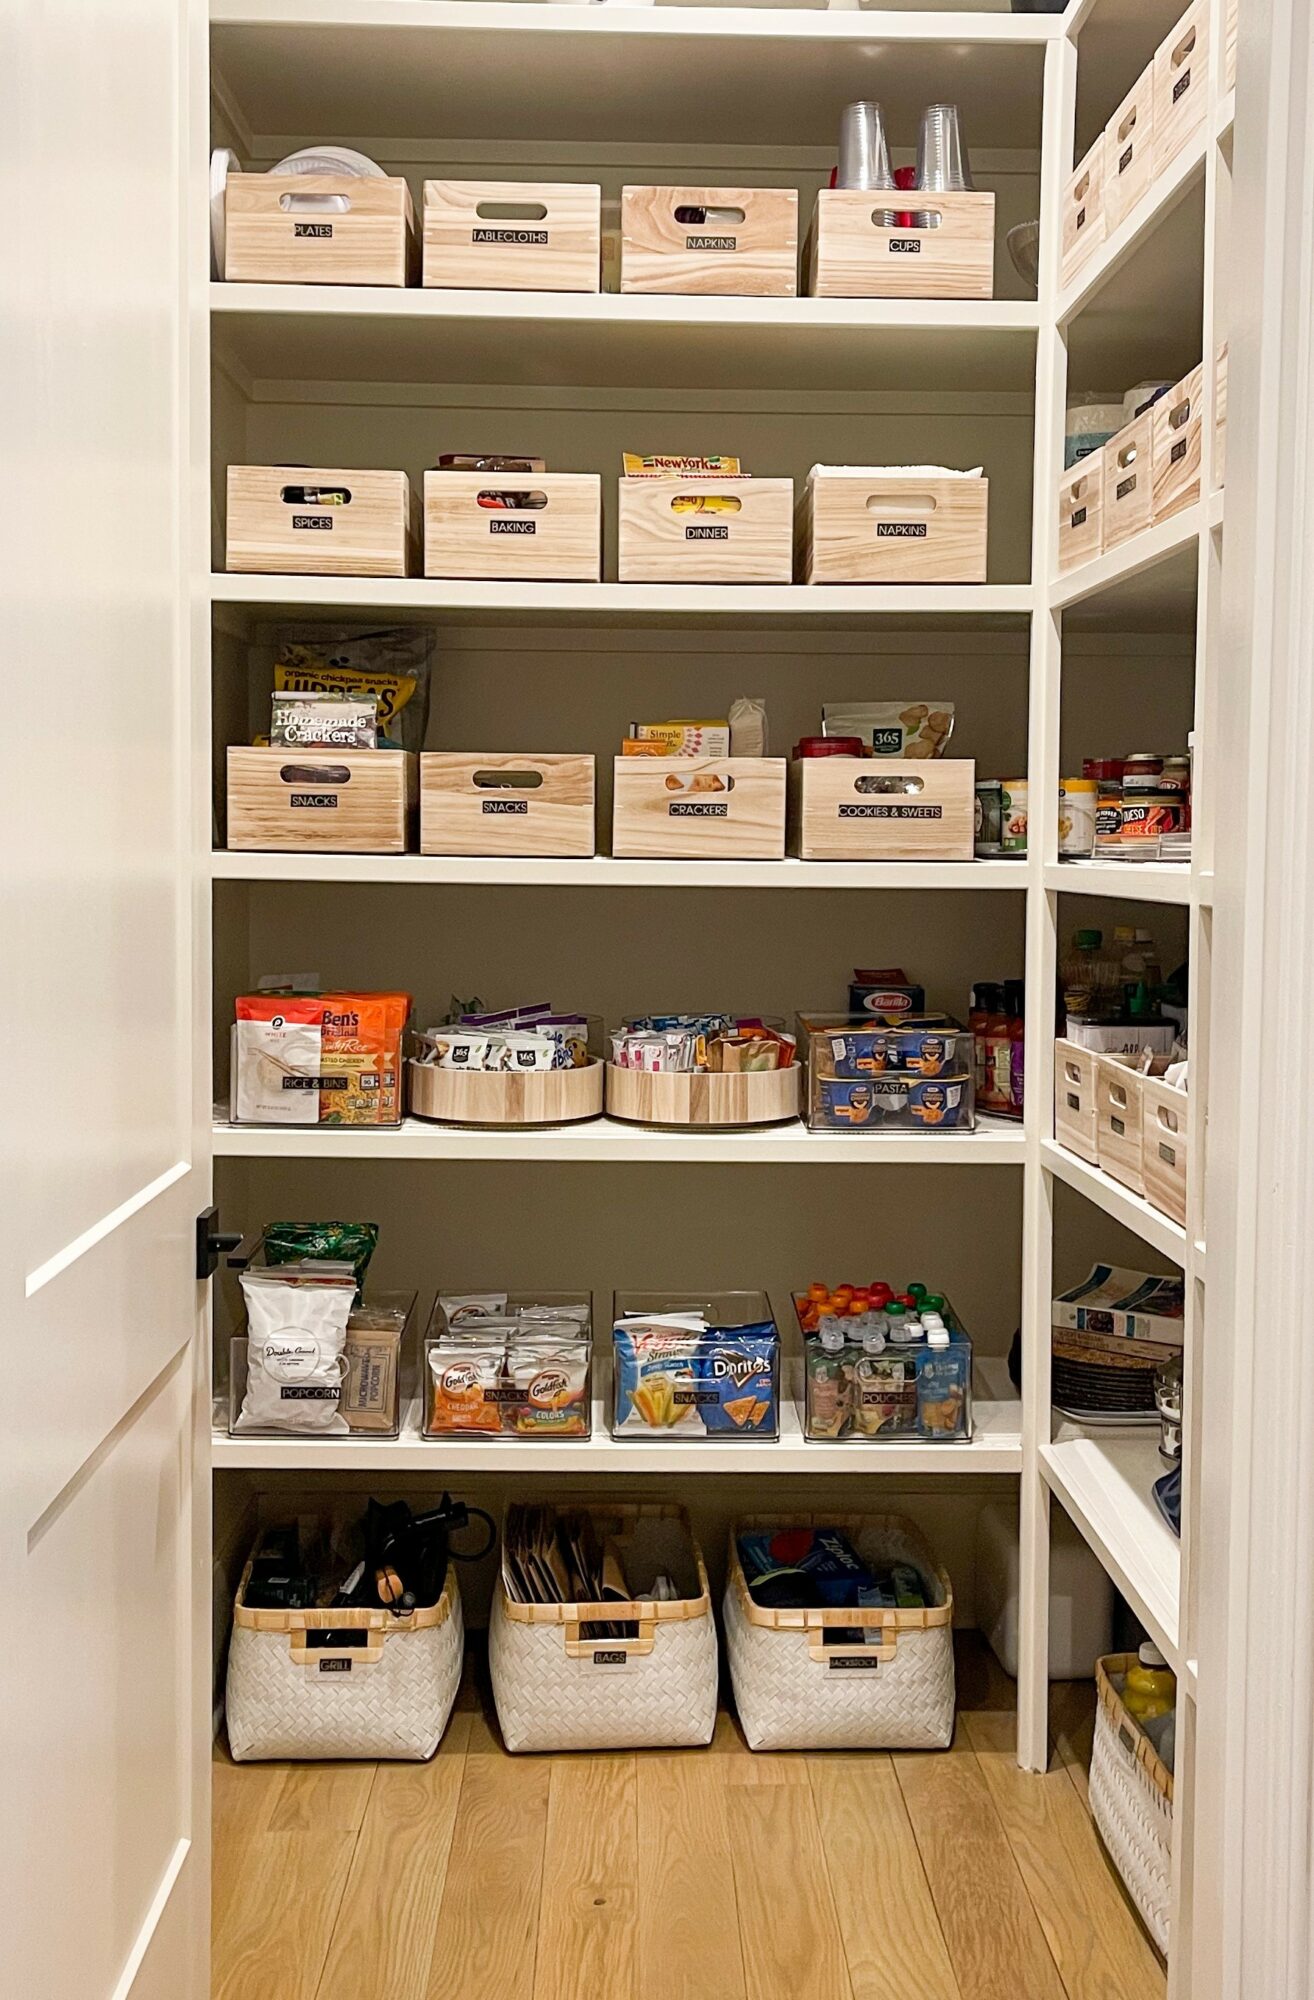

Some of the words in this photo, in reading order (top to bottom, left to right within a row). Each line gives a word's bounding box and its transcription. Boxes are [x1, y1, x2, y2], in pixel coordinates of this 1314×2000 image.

[294, 225, 332, 237] PLATES
[472, 230, 548, 243] TABLECLOTHS
[687, 237, 736, 250] NAPKINS
[890, 240, 920, 252] CUPS
[294, 517, 332, 529] SPICES
[491, 522, 535, 533] BAKING
[686, 527, 728, 539] DINNER
[877, 524, 926, 536] NAPKINS
[284, 669, 320, 681] organic
[320, 673, 363, 684] chickpea
[365, 677, 399, 687] snacks
[275, 711, 367, 729] Homemade
[284, 726, 356, 743] Crackers
[650, 729, 682, 740] Simple
[875, 731, 900, 745] 365
[292, 795, 337, 807] SNACKS
[482, 801, 527, 813] SNACKS
[669, 804, 728, 816] CRACKERS
[838, 805, 889, 817] COOKIES
[890, 806, 899, 817] &
[901, 806, 941, 818] SWEETS
[322, 1010, 359, 1026] Ben's
[454, 1047, 469, 1058] 365
[519, 1053, 535, 1063] 365
[284, 1078, 309, 1089] RICE
[311, 1078, 320, 1088] &
[323, 1078, 348, 1089] BINS
[874, 1084, 908, 1094] PASTA
[714, 1357, 771, 1378] Doritos
[282, 1387, 341, 1399] POPCORN
[532, 1378, 568, 1397] Goldfish
[485, 1391, 528, 1402] SNACKS
[675, 1393, 719, 1403] SNACKS
[863, 1392, 915, 1404] POUCHES
[818, 1536, 860, 1571] Ziploc
[594, 1652, 627, 1663] BAGS
[319, 1659, 352, 1671] GRILL
